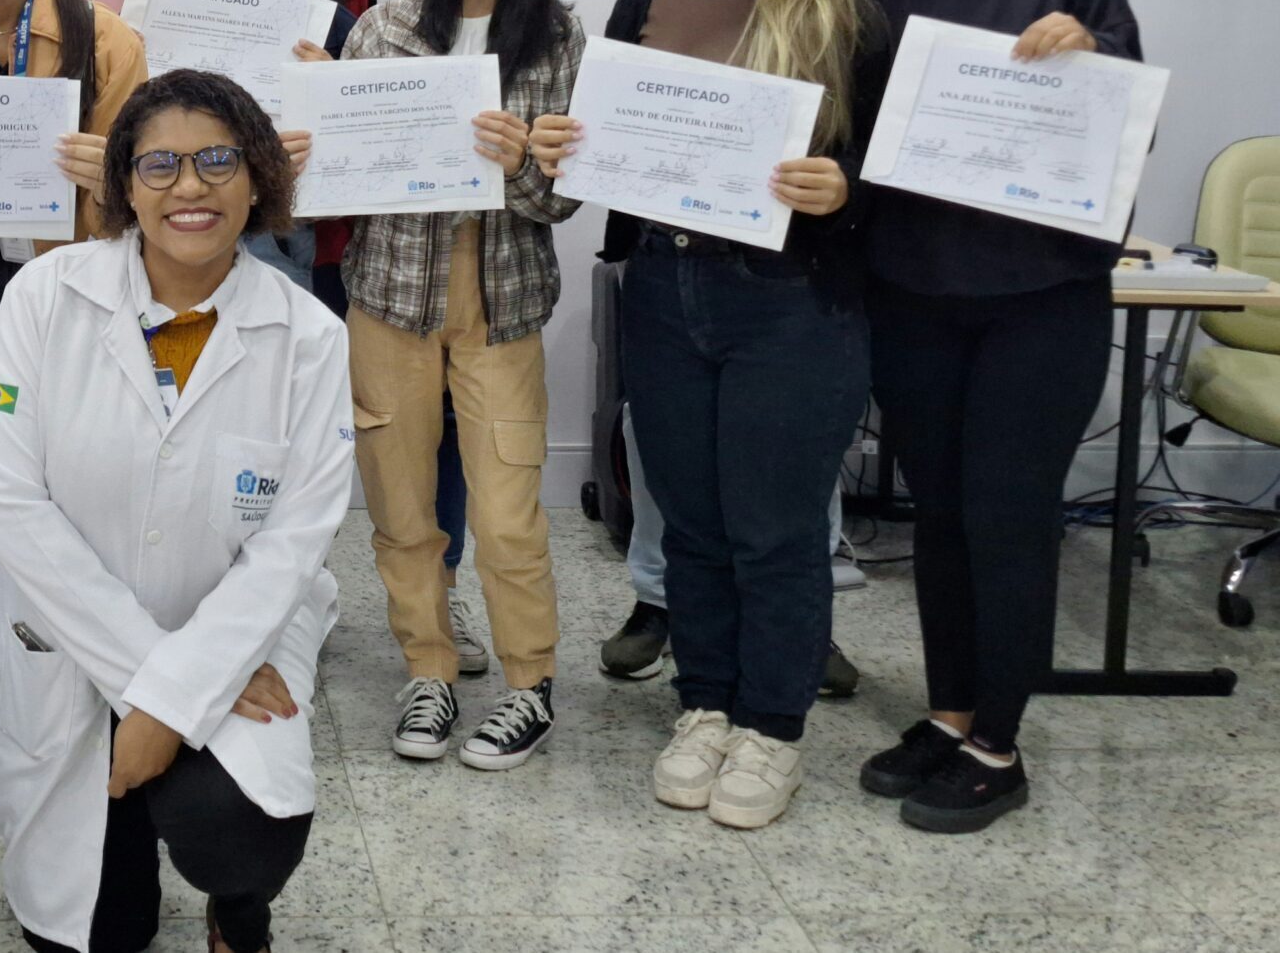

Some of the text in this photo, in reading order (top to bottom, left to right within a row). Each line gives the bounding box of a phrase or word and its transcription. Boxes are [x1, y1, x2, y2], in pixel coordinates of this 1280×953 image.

[957, 63, 1063, 89] CERTIFICADO
[340, 79, 427, 97] CERTIFICADO
[636, 81, 730, 105] CERTIFICADO
[614, 106, 744, 134] SANDY DE OLIVEIRA LISBOA
[418, 181, 436, 190] Rio
[693, 199, 712, 211] Rio
